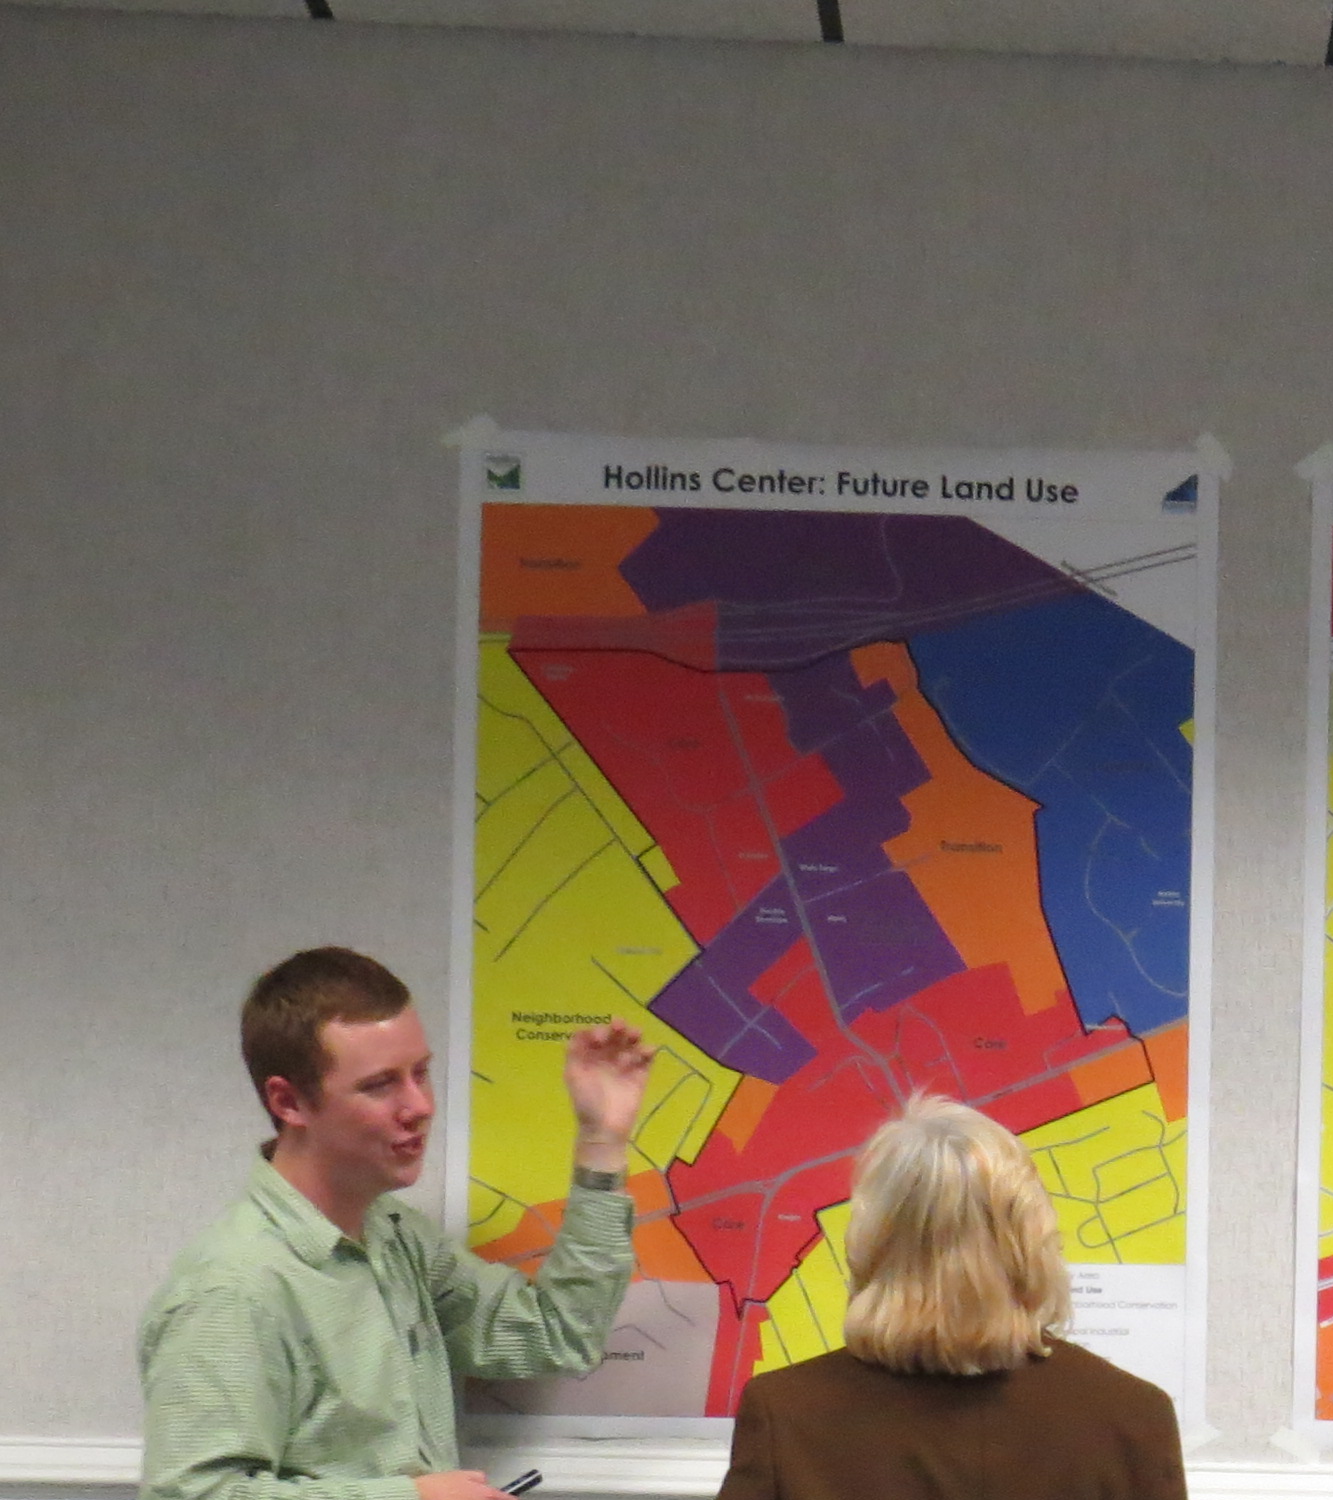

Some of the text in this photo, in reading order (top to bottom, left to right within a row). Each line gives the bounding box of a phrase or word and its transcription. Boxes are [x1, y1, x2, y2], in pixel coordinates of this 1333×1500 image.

[603, 464, 1079, 503] Hollins Center: Future Land Use
[511, 1011, 612, 1026] Neighborhood
[516, 1028, 573, 1041] Conserv
